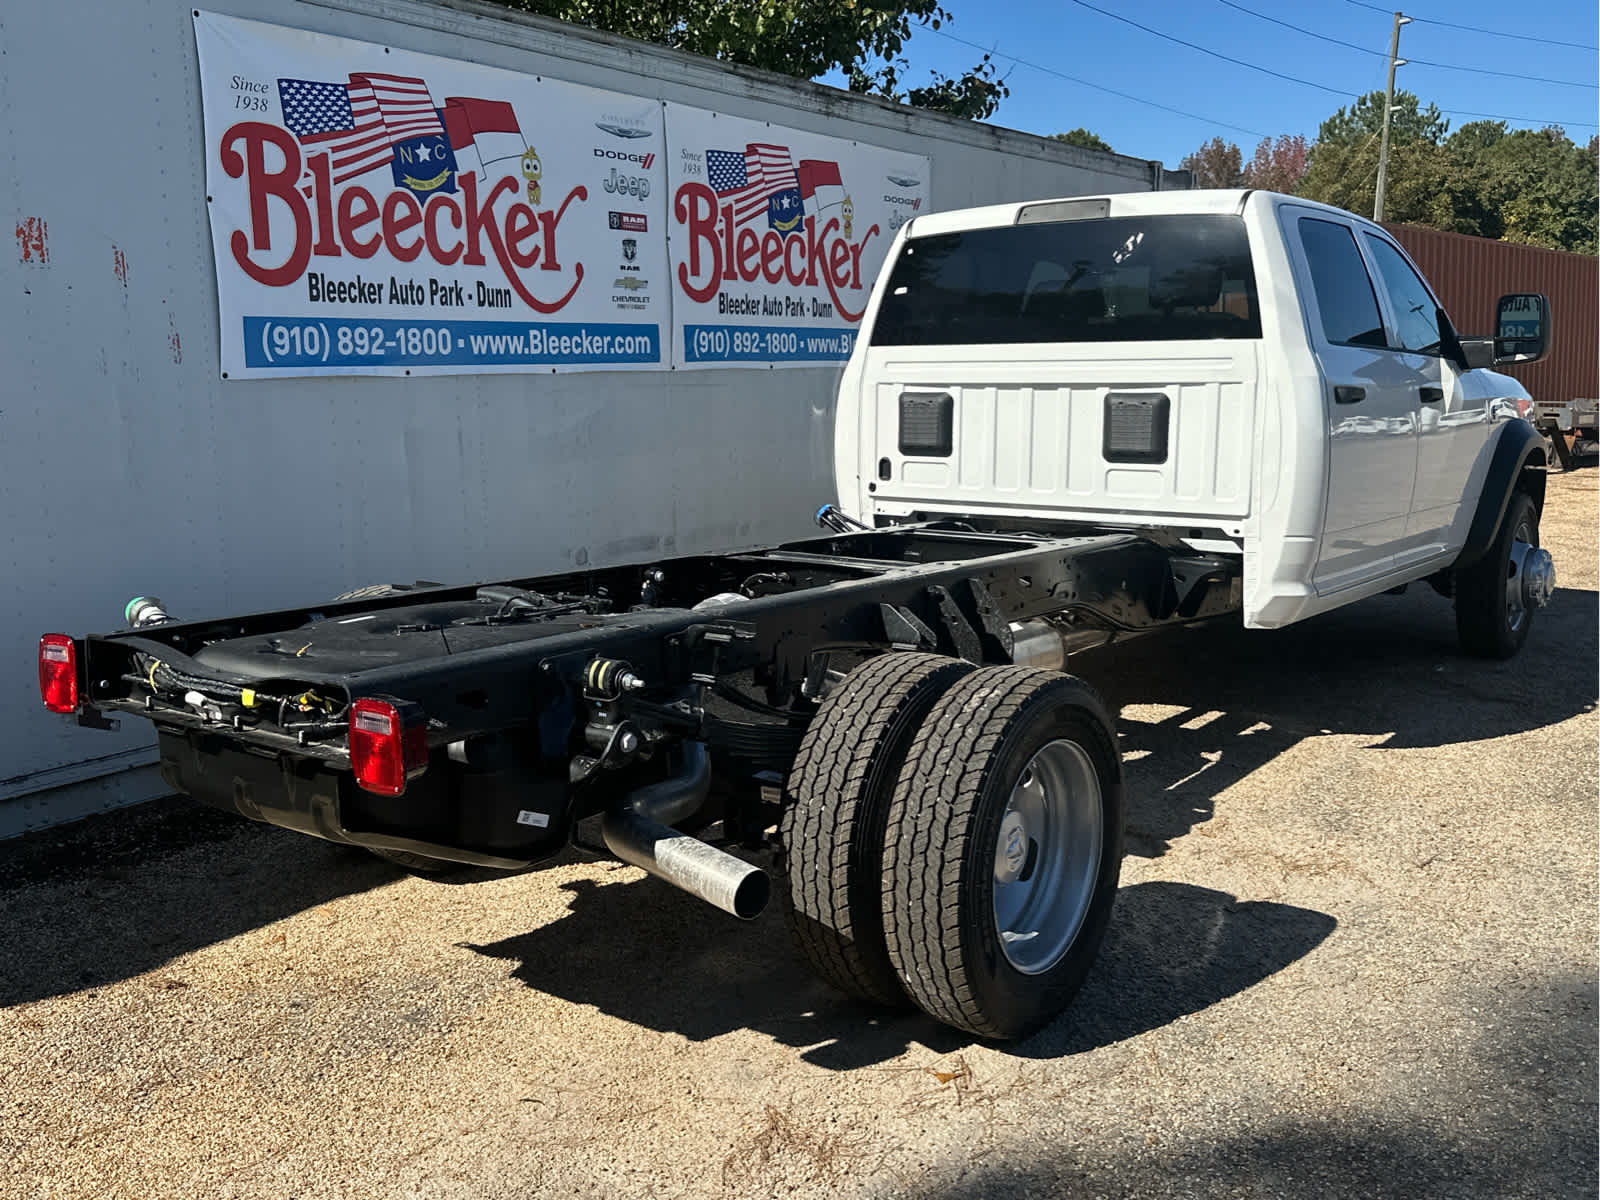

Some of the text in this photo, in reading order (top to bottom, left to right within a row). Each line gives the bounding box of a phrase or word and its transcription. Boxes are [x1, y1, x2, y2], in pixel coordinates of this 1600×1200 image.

[231, 75, 269, 93] Since
[235, 95, 269, 112] 1938
[400, 144, 447, 164] N C
[593, 148, 648, 164] DODGE
[602, 167, 650, 202] Jeep
[220, 122, 588, 314] Bleecker
[622, 215, 645, 224] RAM
[674, 182, 880, 323] Bleecker
[619, 264, 641, 272] RAM
[307, 272, 512, 308] Bleecker Auto Park Dunn
[718, 292, 832, 318] Bleecker Auto Park Dunn
[262, 321, 651, 363] (910) 892-1800 www.Bleecker.com
[693, 328, 730, 358] (910)
[733, 331, 797, 354] 892-1800
